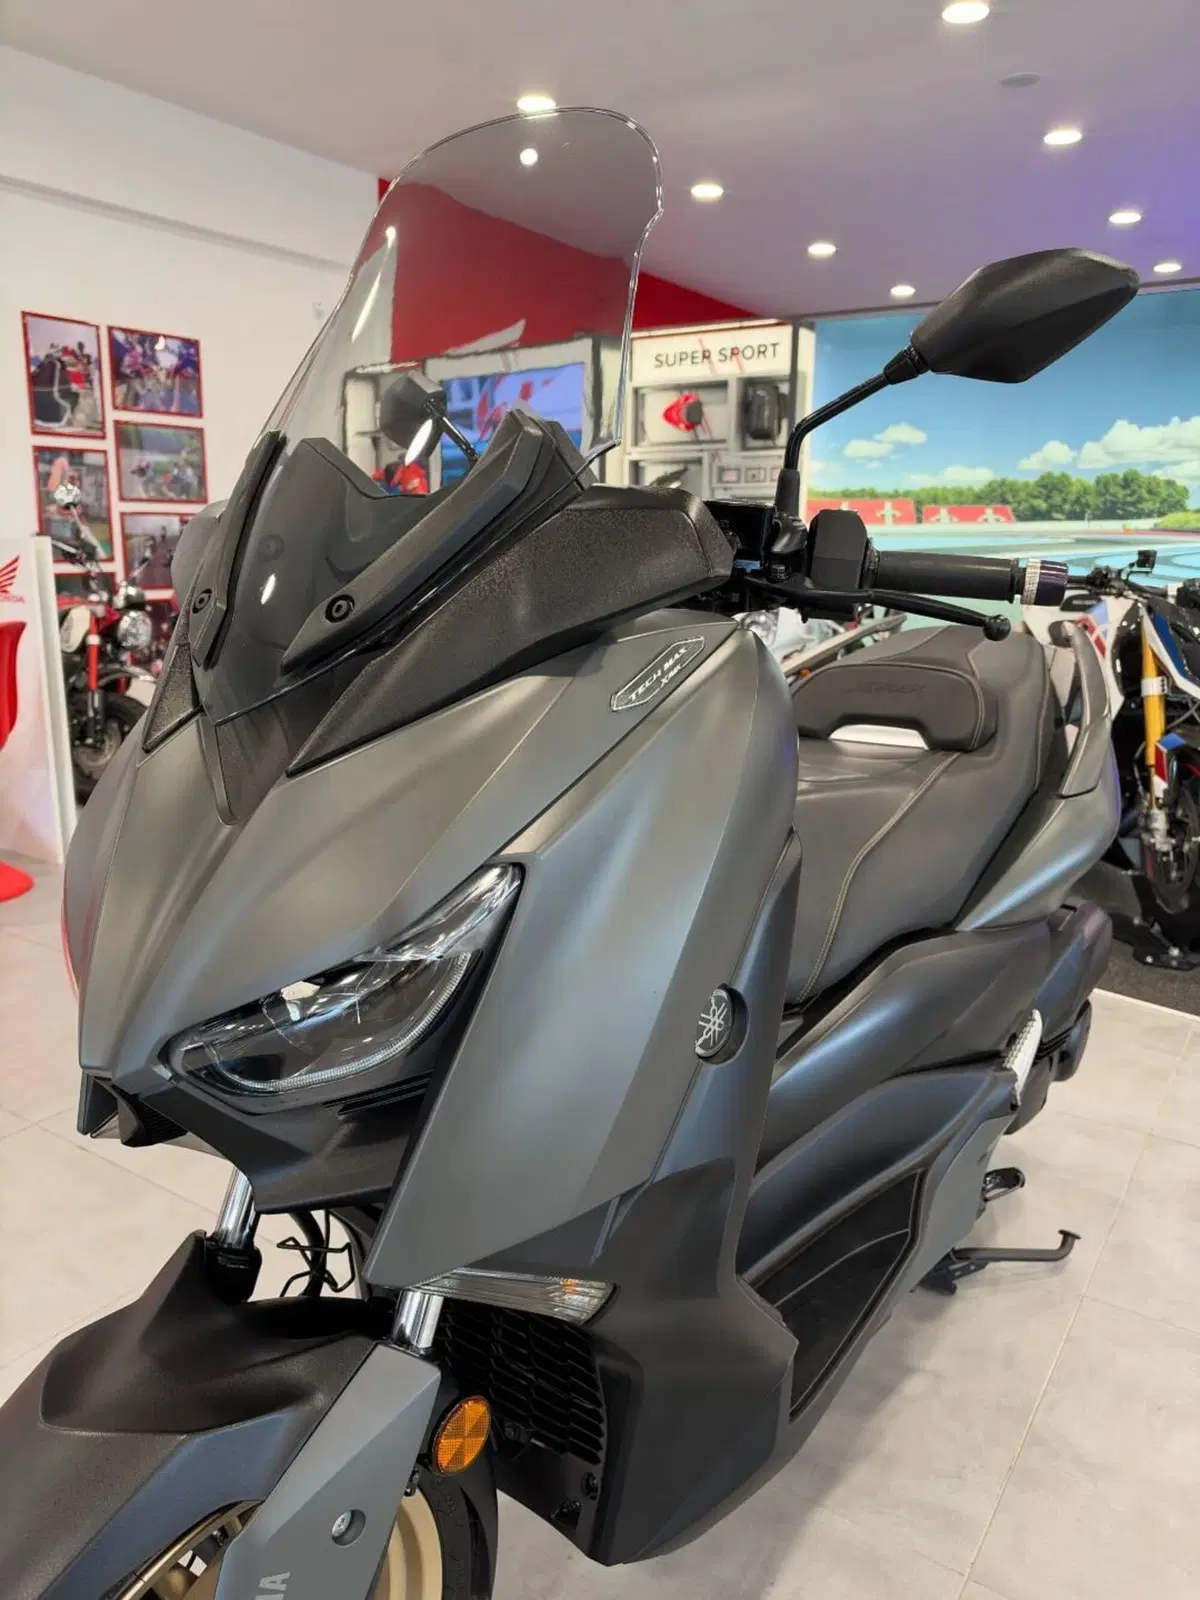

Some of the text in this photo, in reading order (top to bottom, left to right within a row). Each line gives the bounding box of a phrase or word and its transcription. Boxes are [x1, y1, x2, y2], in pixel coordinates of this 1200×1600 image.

[654, 342, 780, 368] SUPER SPORT
[628, 646, 687, 701] TECH MAX
